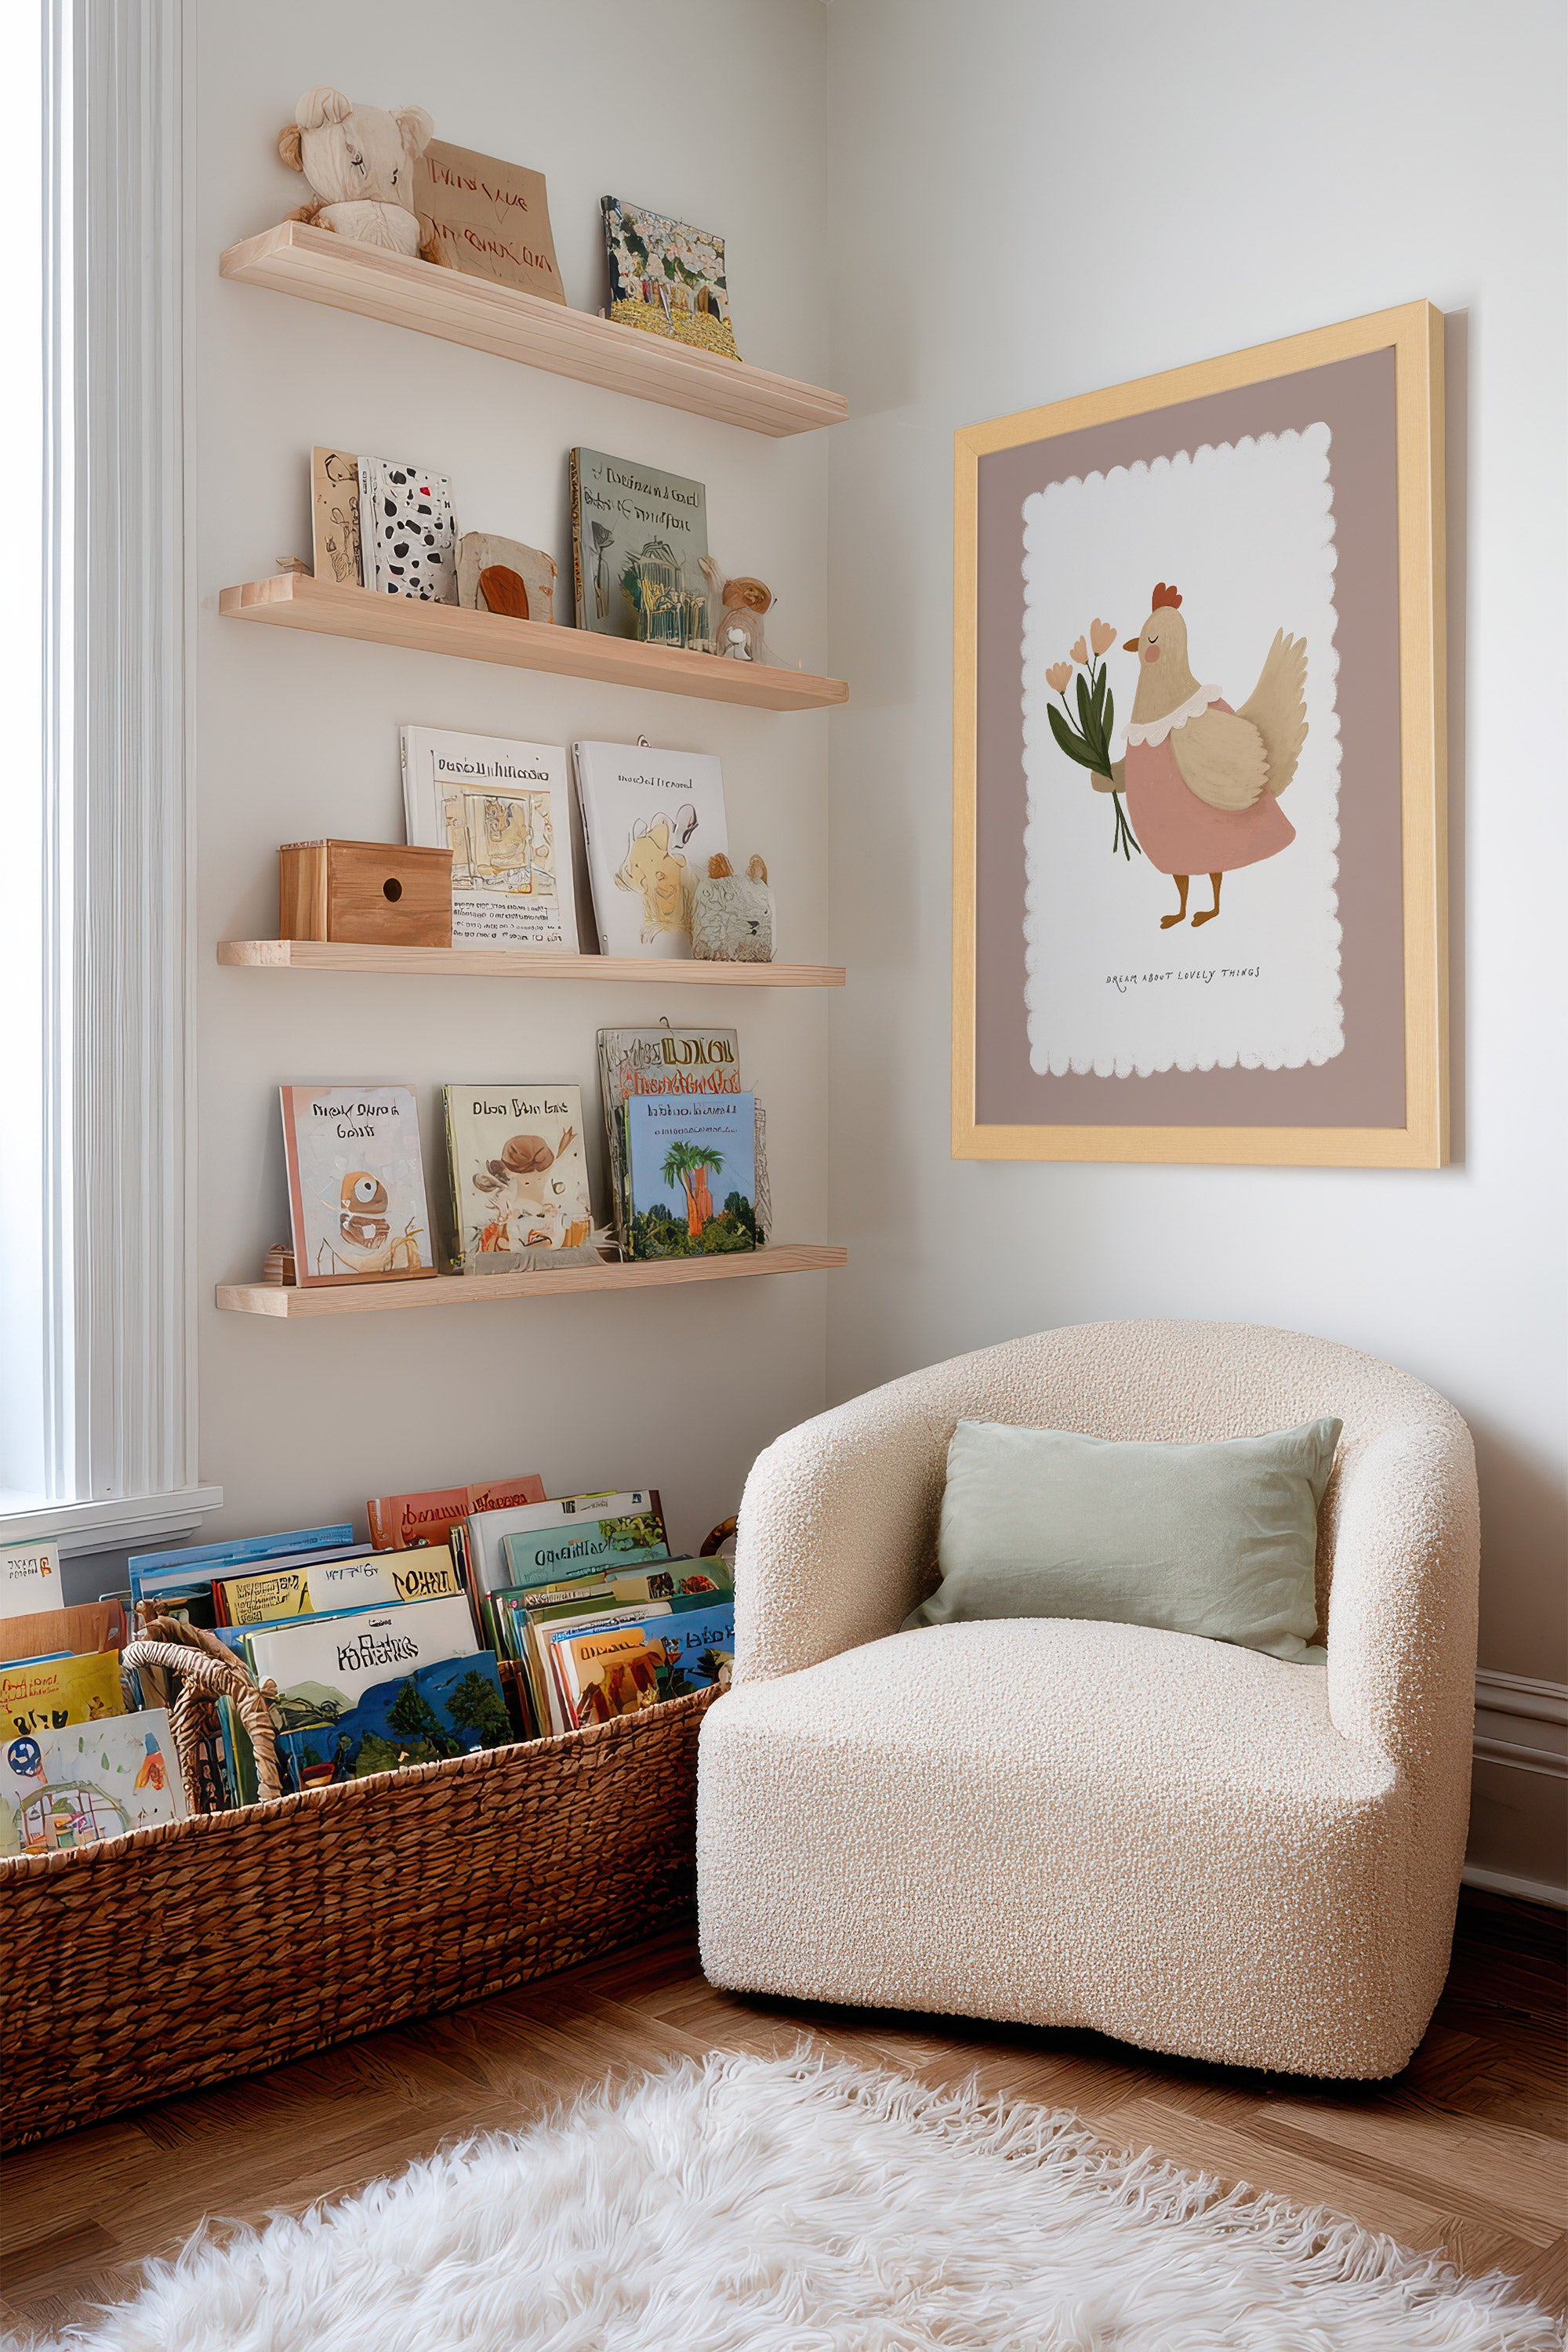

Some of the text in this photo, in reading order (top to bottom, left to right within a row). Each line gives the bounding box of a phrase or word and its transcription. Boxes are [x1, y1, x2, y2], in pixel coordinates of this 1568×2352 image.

[1105, 966, 1260, 993] DREAM ABOUT LOVELY THINGS
